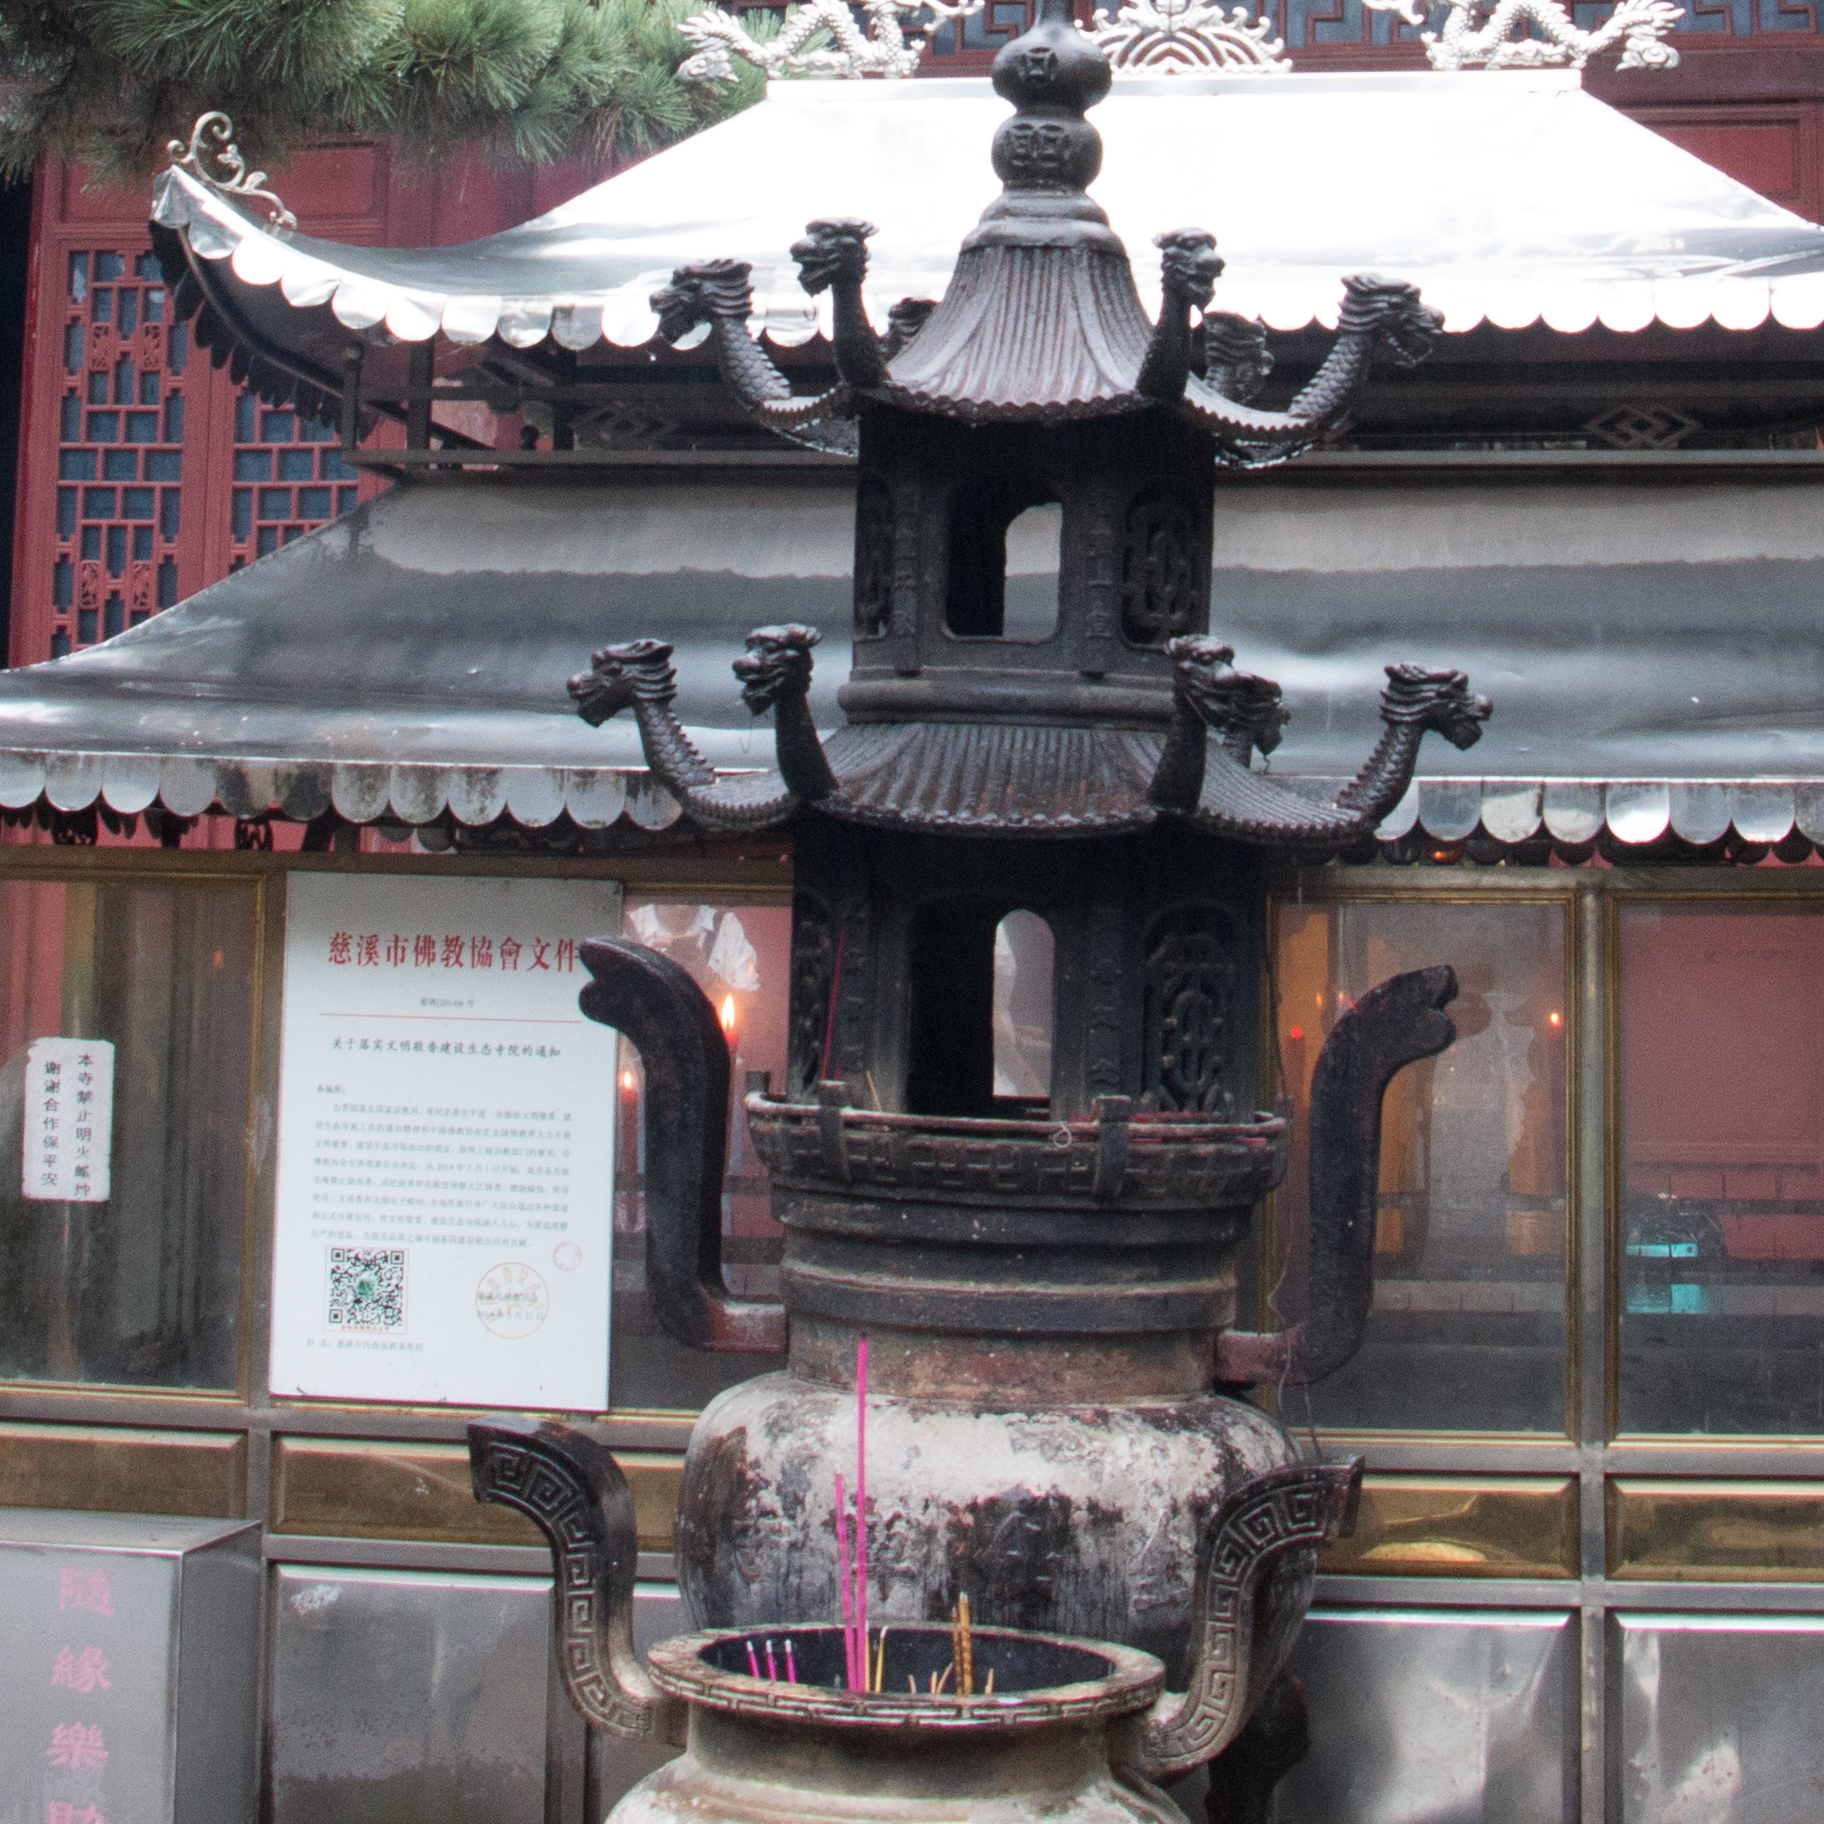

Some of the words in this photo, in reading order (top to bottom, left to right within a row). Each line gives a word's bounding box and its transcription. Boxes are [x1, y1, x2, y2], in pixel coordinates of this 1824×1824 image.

[328, 931, 579, 973] 慈溪市佛教協會文件
